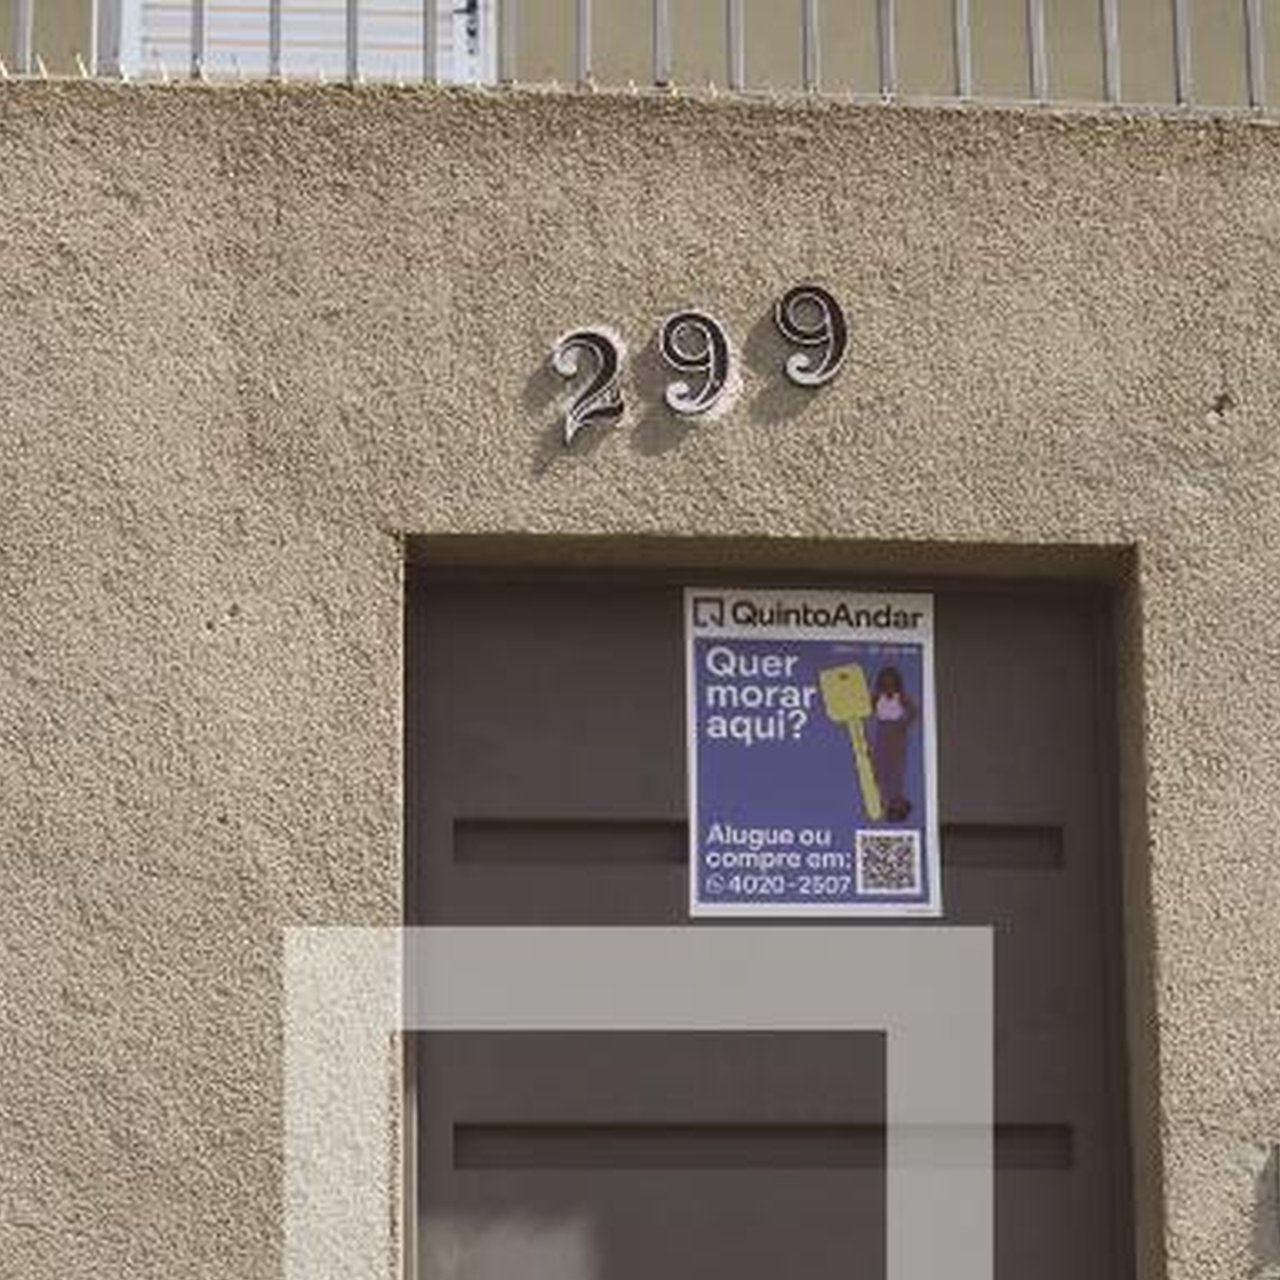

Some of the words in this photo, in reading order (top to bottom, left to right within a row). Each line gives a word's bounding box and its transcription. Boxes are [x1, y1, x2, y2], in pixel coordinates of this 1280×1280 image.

[552, 285, 847, 448] 299
[732, 602, 924, 628] QuintoAndar
[705, 646, 799, 677] Quer
[706, 683, 817, 709] morar
[706, 710, 808, 746] aqui?
[705, 824, 795, 851] Alugue
[799, 829, 832, 846] ou
[705, 850, 802, 870] compre
[806, 851, 852, 869] em:
